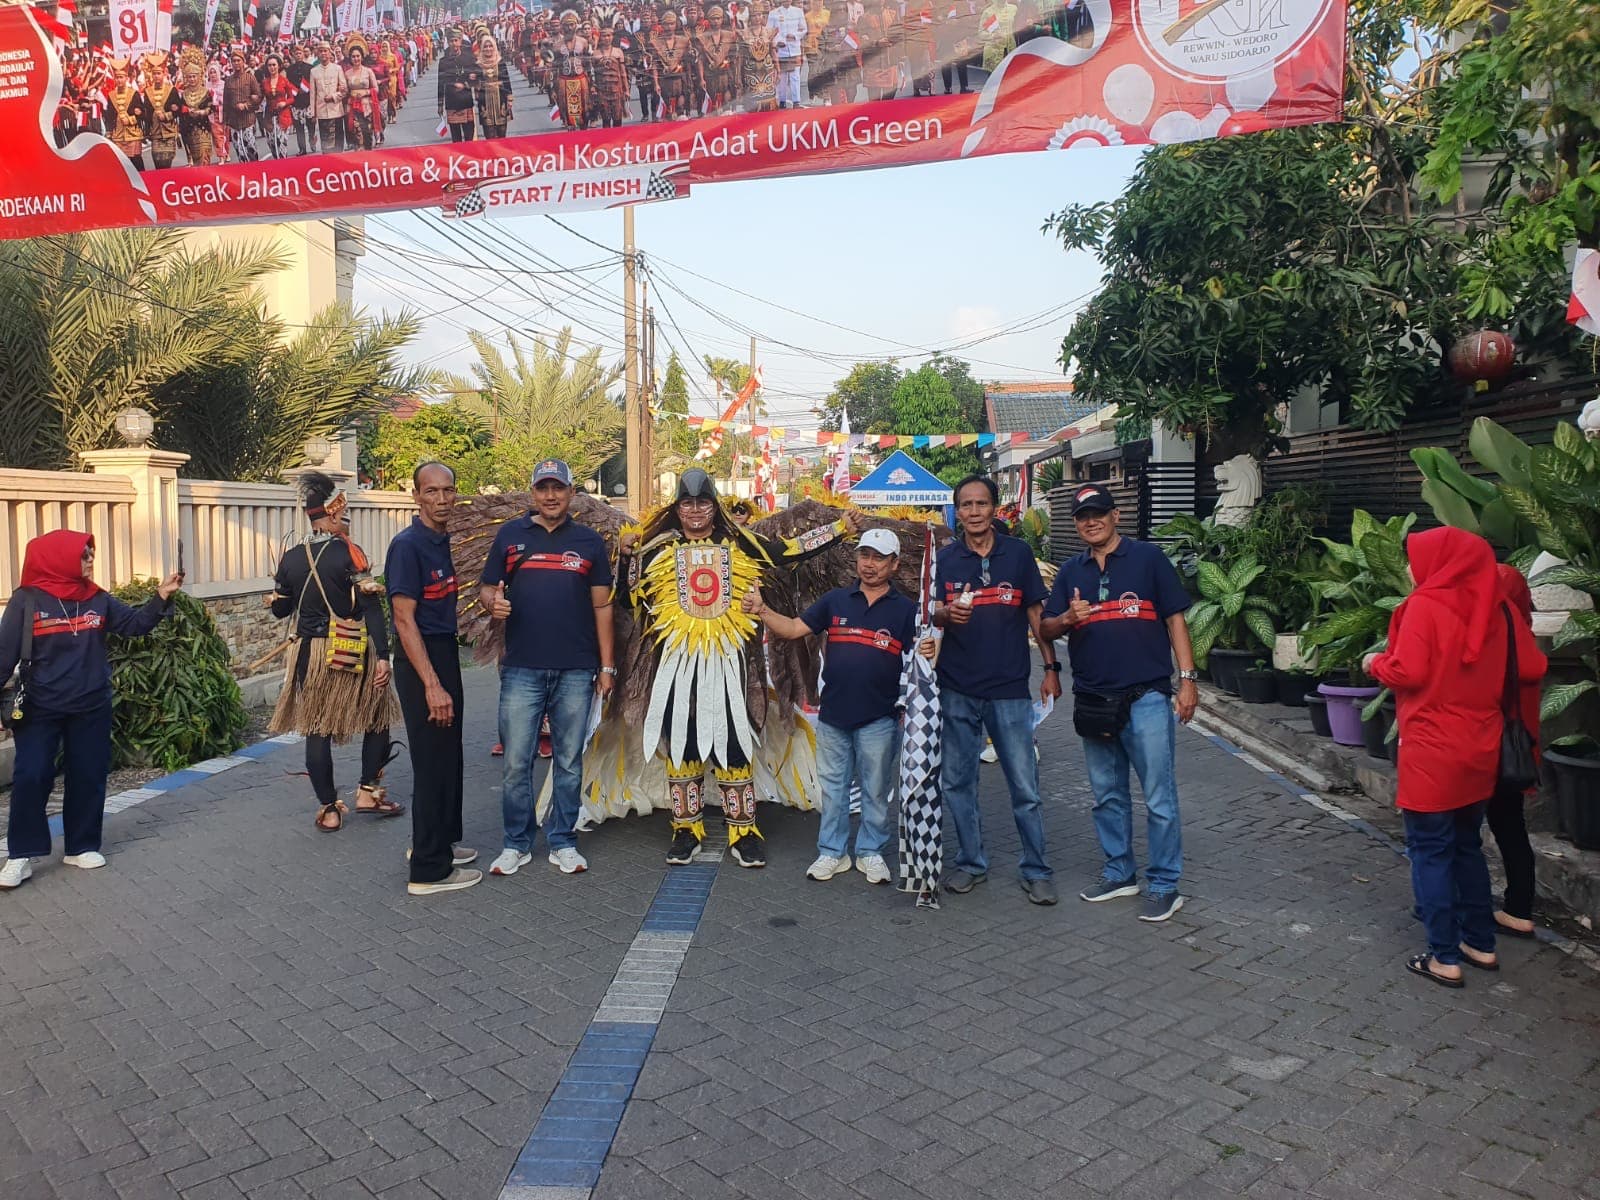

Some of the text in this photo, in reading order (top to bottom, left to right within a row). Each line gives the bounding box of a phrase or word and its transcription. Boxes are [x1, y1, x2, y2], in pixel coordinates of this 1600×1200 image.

[118, 9, 149, 44] 81
[1183, 40, 1225, 53] REWWIN
[1233, 32, 1278, 46] WEDORO
[1190, 45, 1271, 63] WARU SIDOARJO
[161, 116, 943, 207] Gerak Jalan Gembira & Karnaval Kostum Adat UKM Green
[70, 193, 86, 212] RI
[488, 178, 641, 206] START / FINISH
[886, 494, 907, 502] INDO
[909, 494, 948, 502] PERKASA
[691, 549, 715, 565] RT
[689, 567, 720, 607] 9
